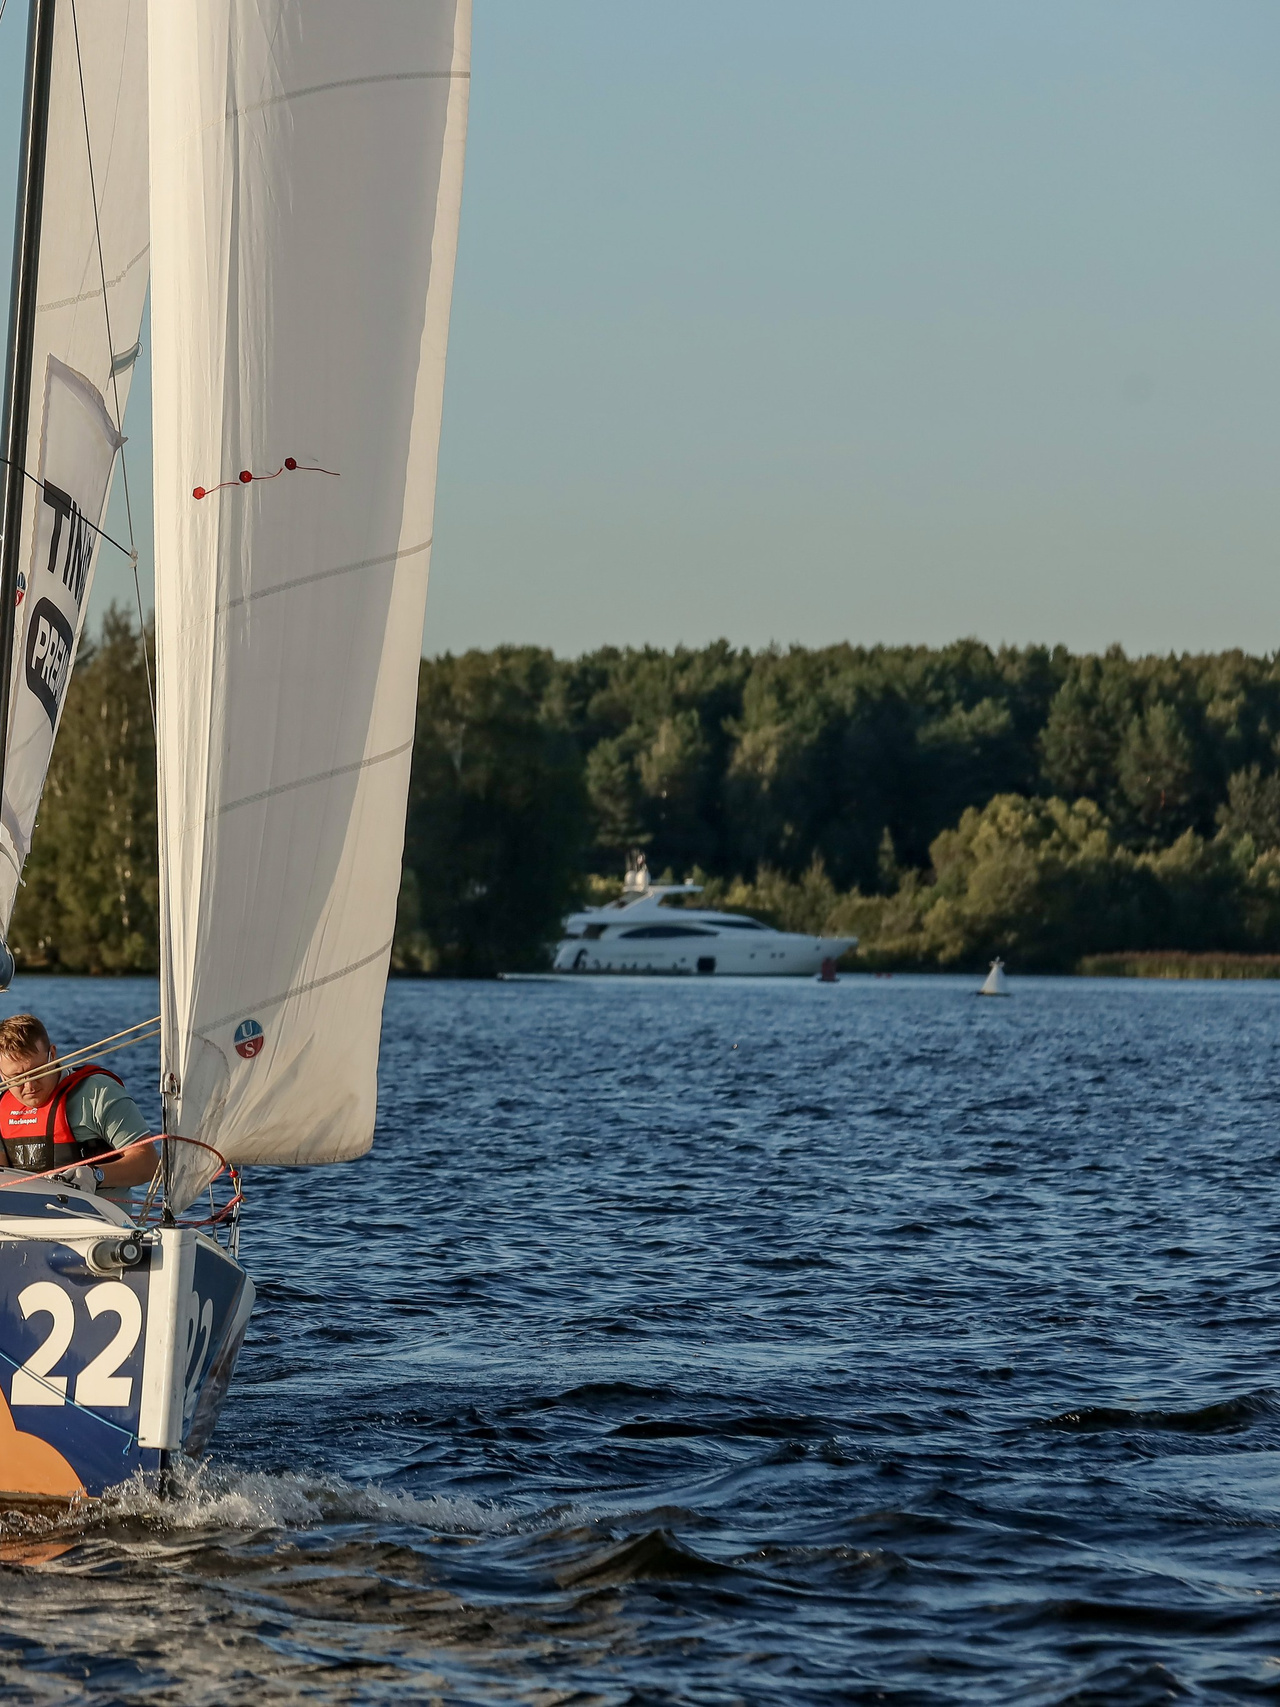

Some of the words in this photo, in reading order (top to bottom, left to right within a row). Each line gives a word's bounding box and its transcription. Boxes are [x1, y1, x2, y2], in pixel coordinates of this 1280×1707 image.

[241, 1021, 253, 1037] U
[245, 1042, 255, 1057] S
[10, 1281, 142, 1407] 22
